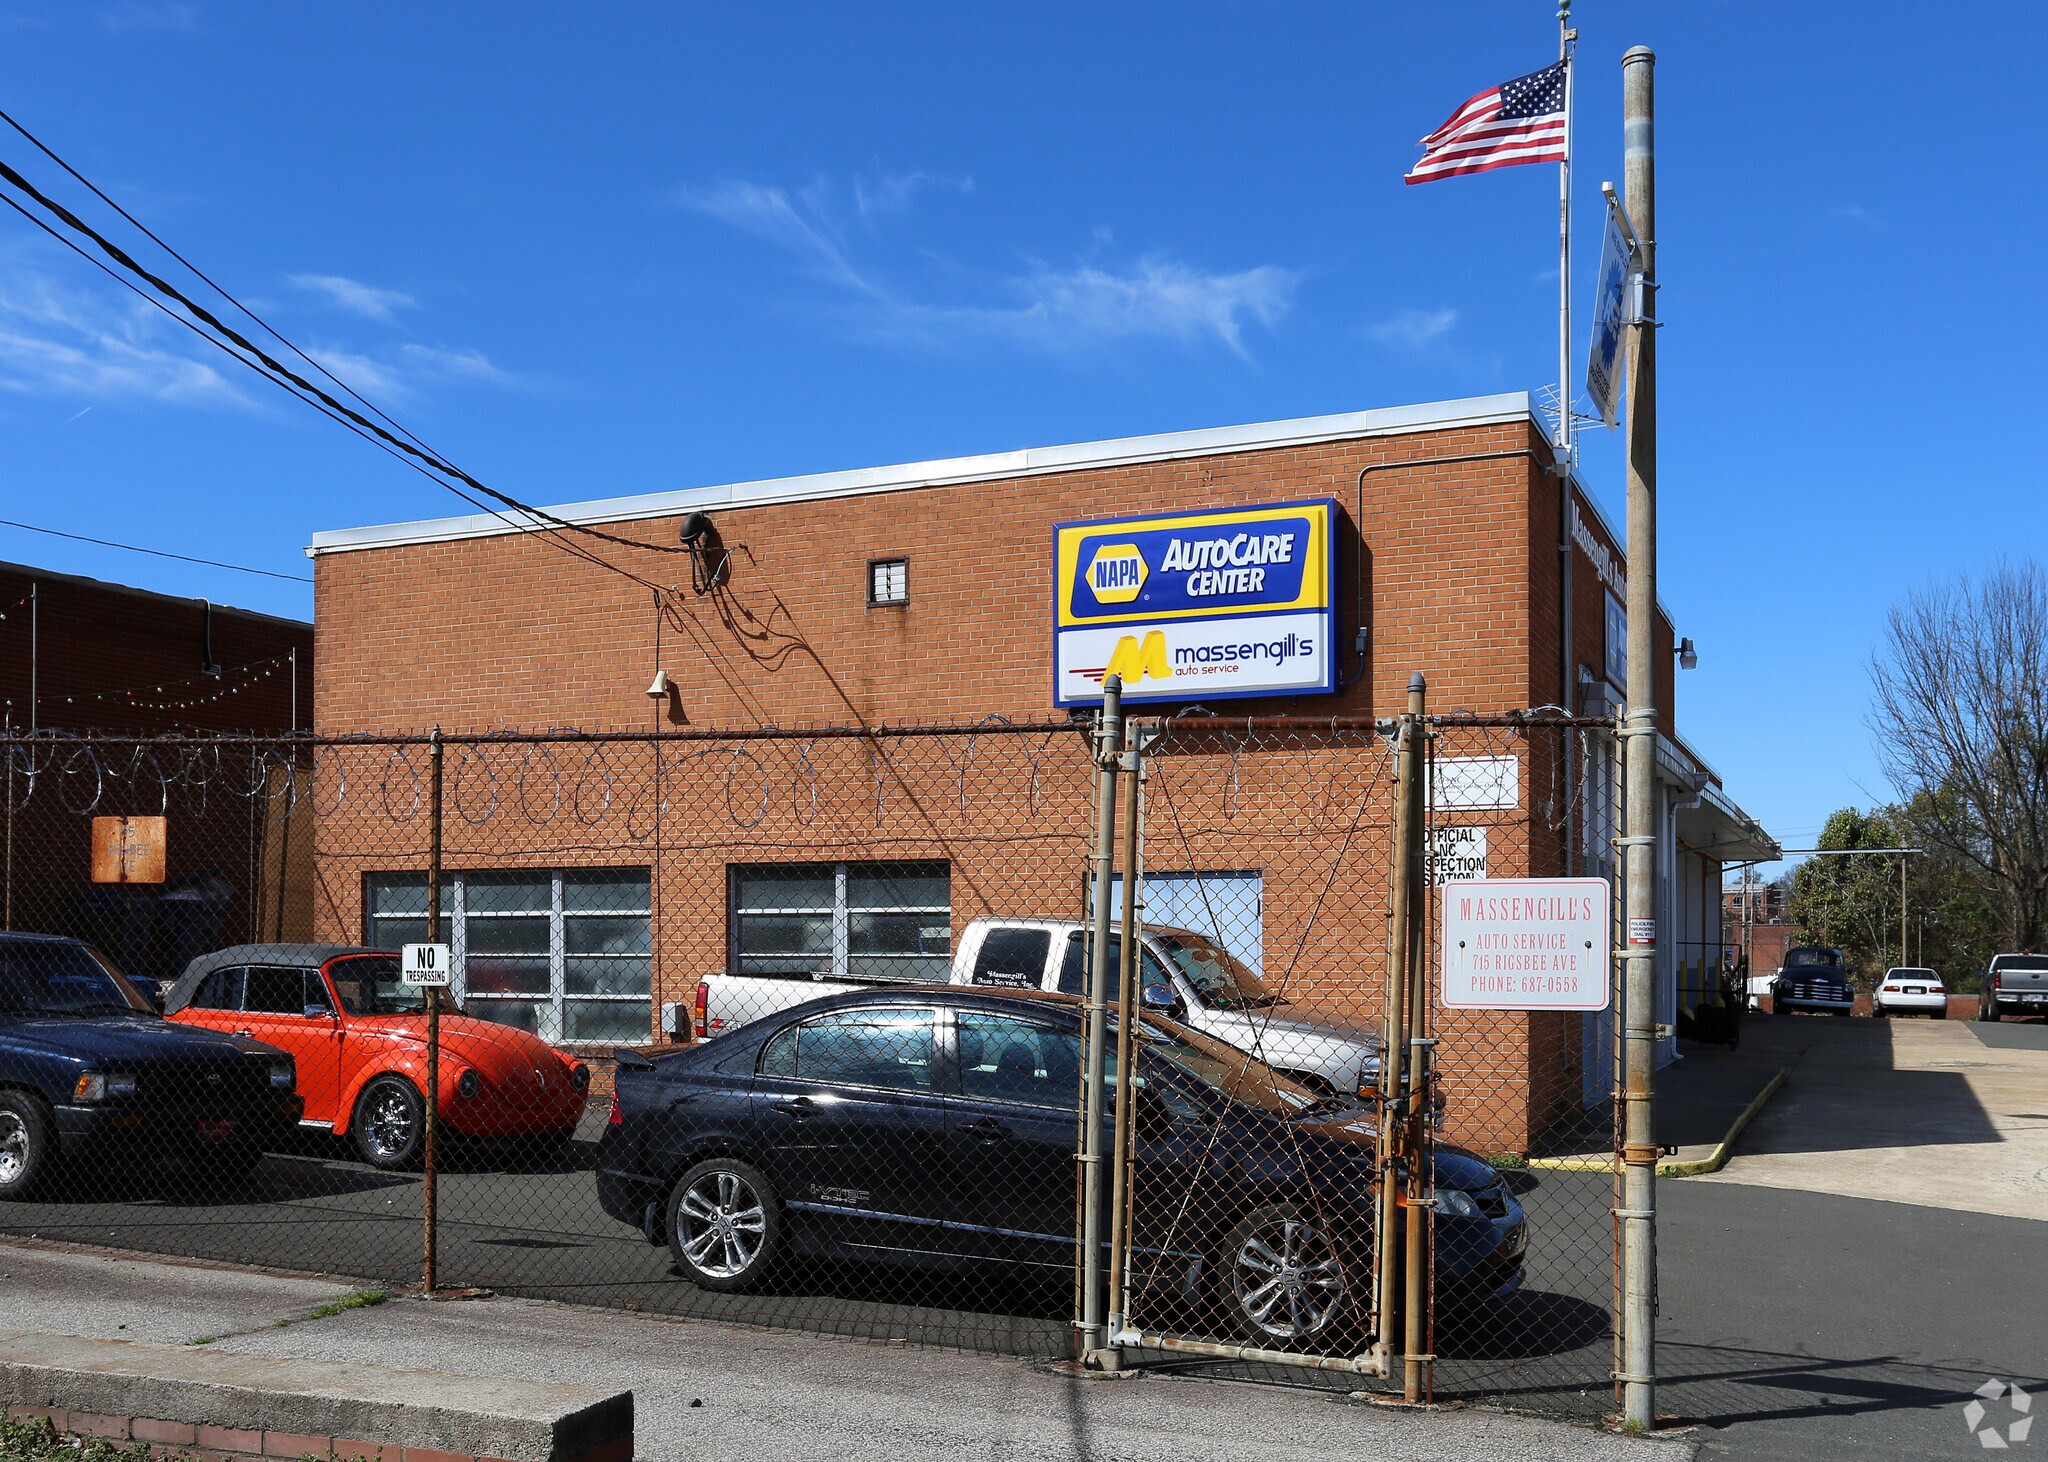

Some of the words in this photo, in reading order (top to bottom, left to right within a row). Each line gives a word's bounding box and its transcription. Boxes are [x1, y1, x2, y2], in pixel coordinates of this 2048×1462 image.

[1096, 558, 1140, 588] NAPA
[1186, 567, 1266, 597] CENTER
[1175, 633, 1313, 666] massengill's
[1175, 665, 1199, 676] auto
[1201, 663, 1239, 675] service
[1424, 829, 1475, 843] OFICIAL
[1440, 843, 1456, 857] NC
[1425, 857, 1485, 872] SPECTION
[1460, 896, 1591, 921] MASSENGILL'S
[1476, 933, 1508, 950] AUTO
[1513, 933, 1566, 950] SERVICE
[417, 947, 435, 969] NO
[1473, 954, 1490, 970] 715
[1495, 954, 1547, 971] RIGSBEE
[1552, 954, 1577, 971] AVE
[405, 970, 446, 982] TRESPASSING
[1471, 976, 1516, 992] PHONE:
[1521, 976, 1578, 993] 687-0558
